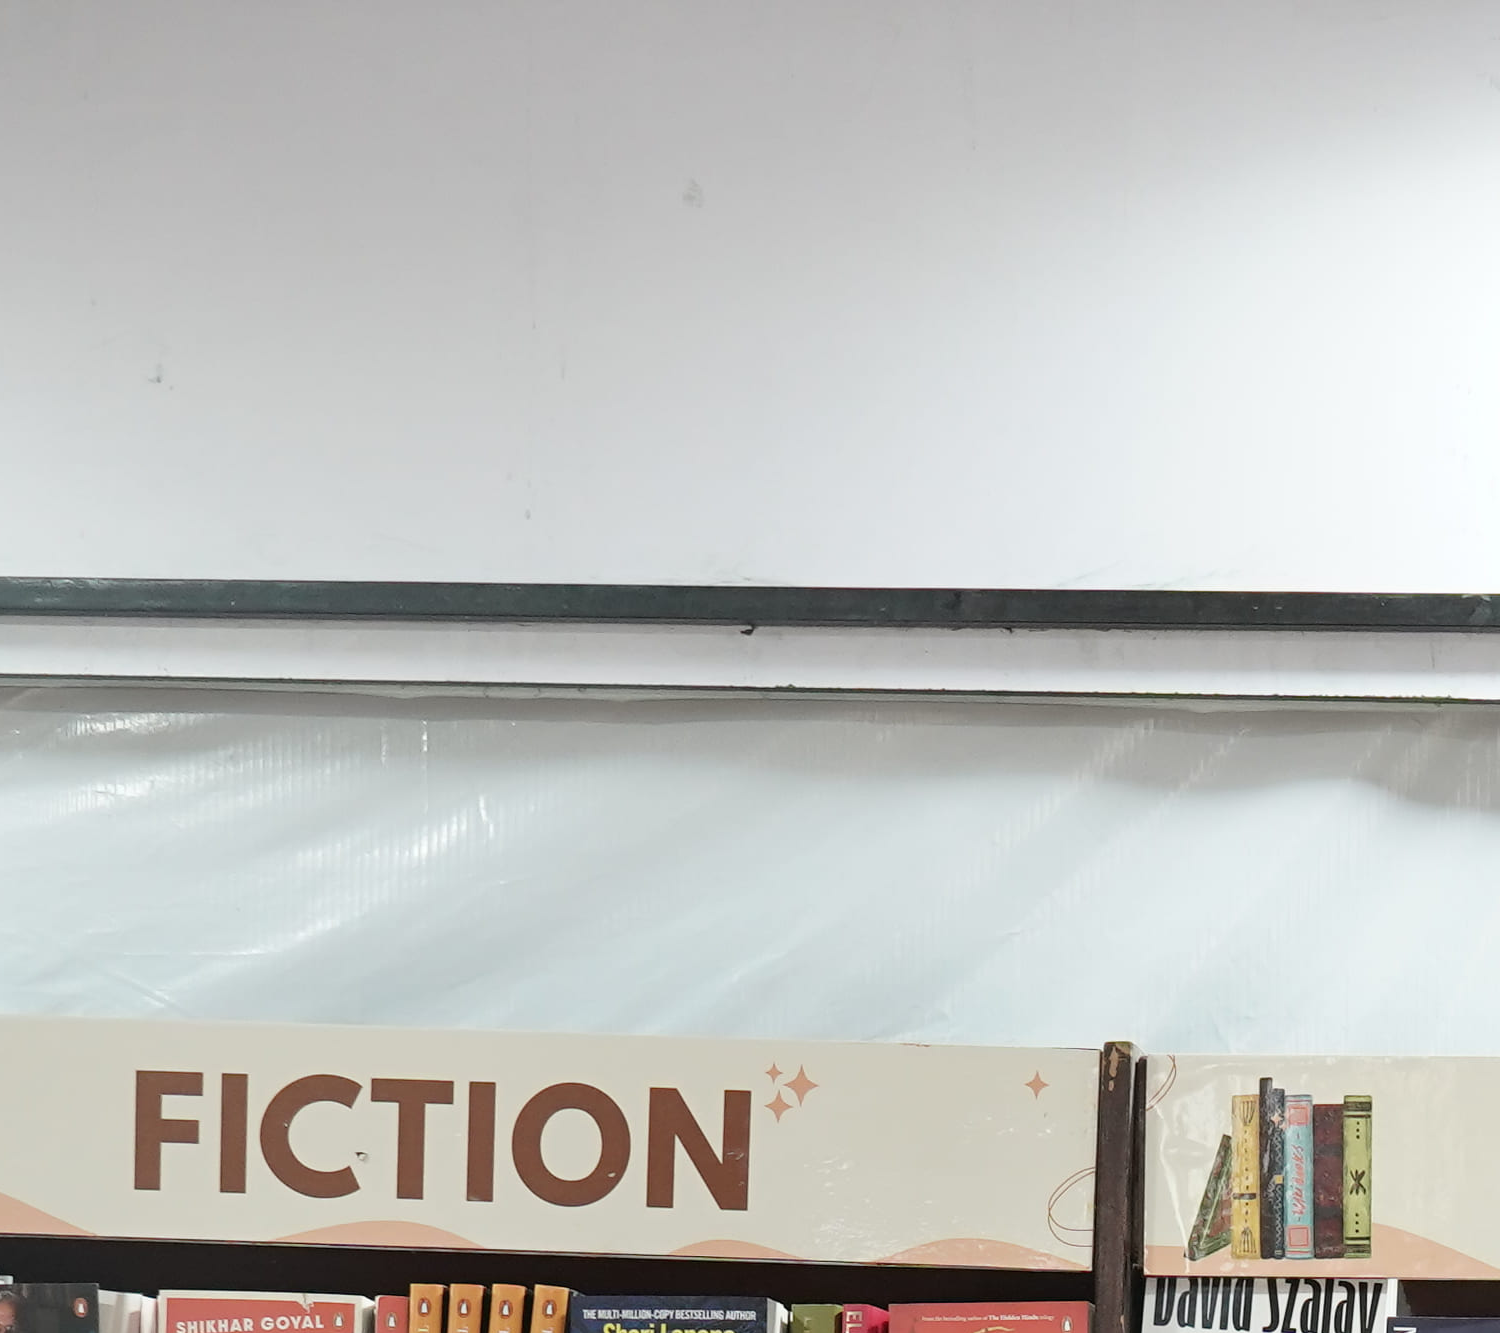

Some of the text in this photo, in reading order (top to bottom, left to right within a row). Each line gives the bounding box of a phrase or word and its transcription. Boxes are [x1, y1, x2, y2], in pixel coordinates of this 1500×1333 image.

[134, 1069, 752, 1211] FICTION
[262, 1315, 325, 1332] GOYAL
[583, 1309, 598, 1318] THE
[675, 1310, 724, 1321] BESTSELLING
[726, 1311, 757, 1321] AUTHOR
